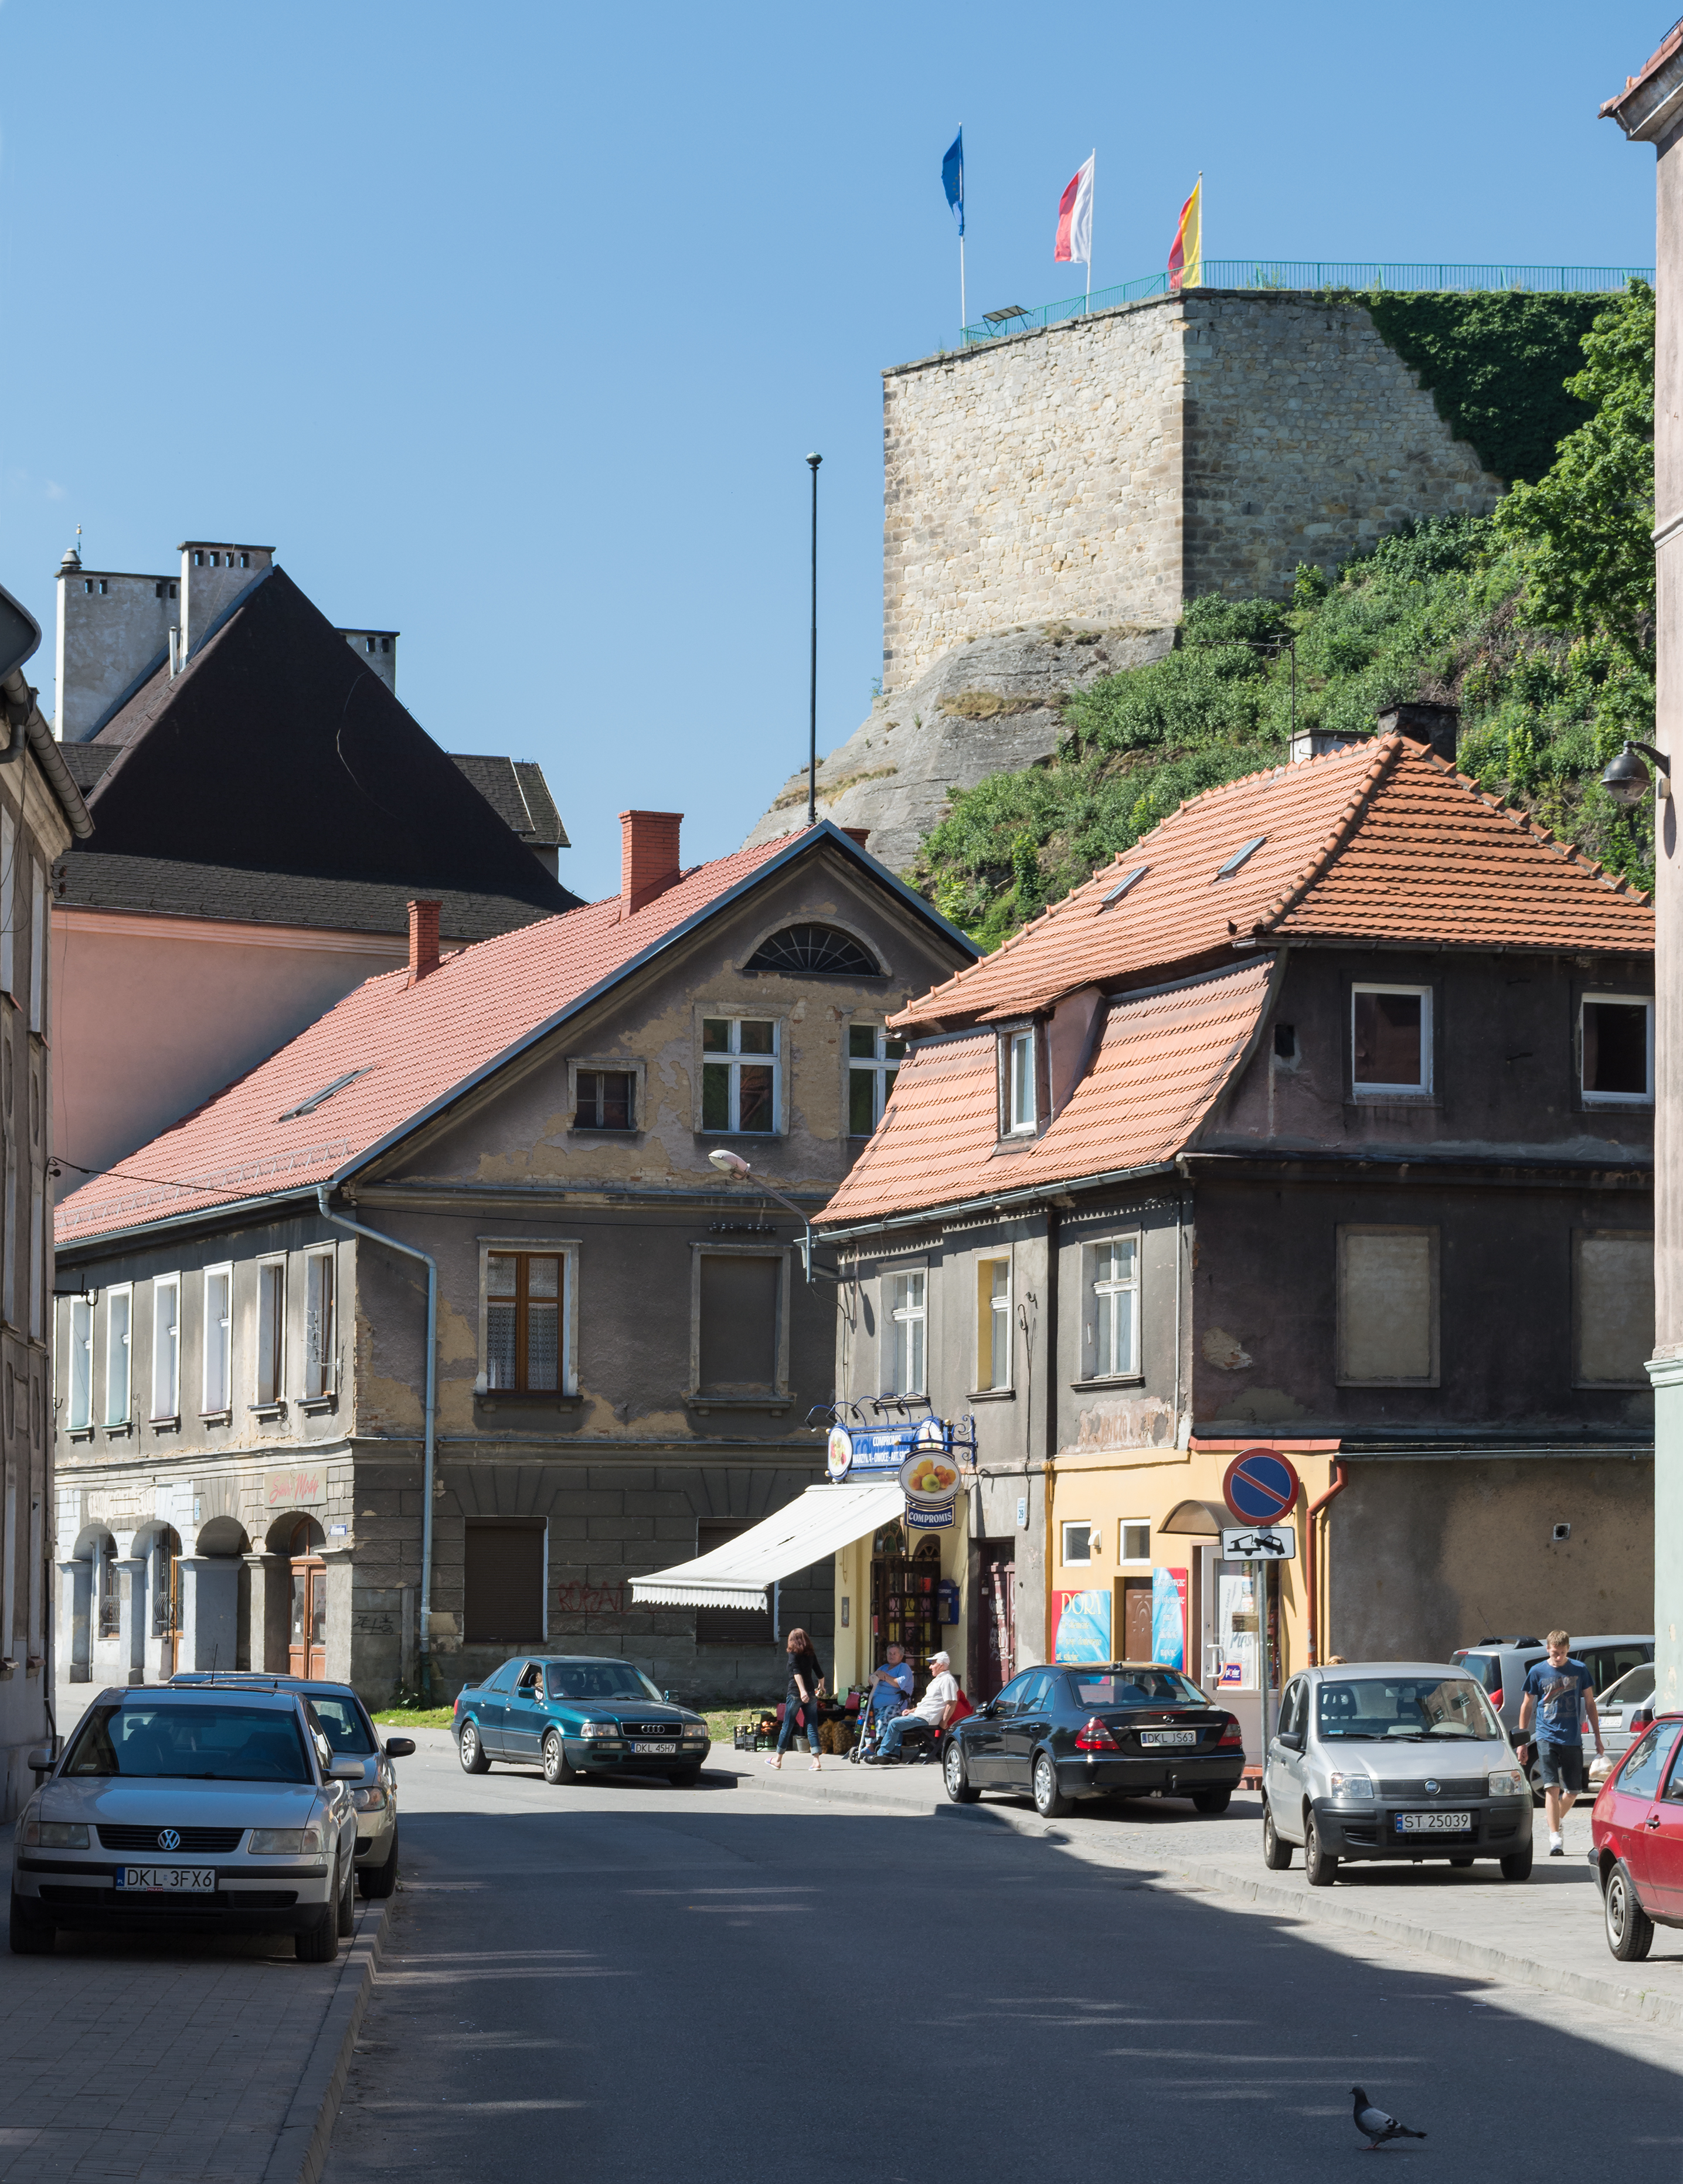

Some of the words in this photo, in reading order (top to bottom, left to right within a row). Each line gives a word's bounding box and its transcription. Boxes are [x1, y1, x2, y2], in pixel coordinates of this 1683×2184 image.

[873, 1435, 901, 1447] COMPROMIS
[874, 1452, 889, 1463] OWOCE
[294, 1473, 319, 1502] Mody
[909, 1512, 952, 1523] COMPROMIS
[1018, 1509, 1024, 1519] 29
[1061, 1593, 1101, 1615] DORA
[1147, 1734, 1168, 1743] DKL
[1172, 1733, 1194, 1742] JS63
[636, 1744, 652, 1752] DKL
[655, 1744, 674, 1752] 45H7
[1405, 1815, 1423, 1828] ST
[1428, 1814, 1468, 1828] 25039
[127, 1869, 163, 1886] DKL
[170, 1870, 212, 1887] 3FX6
